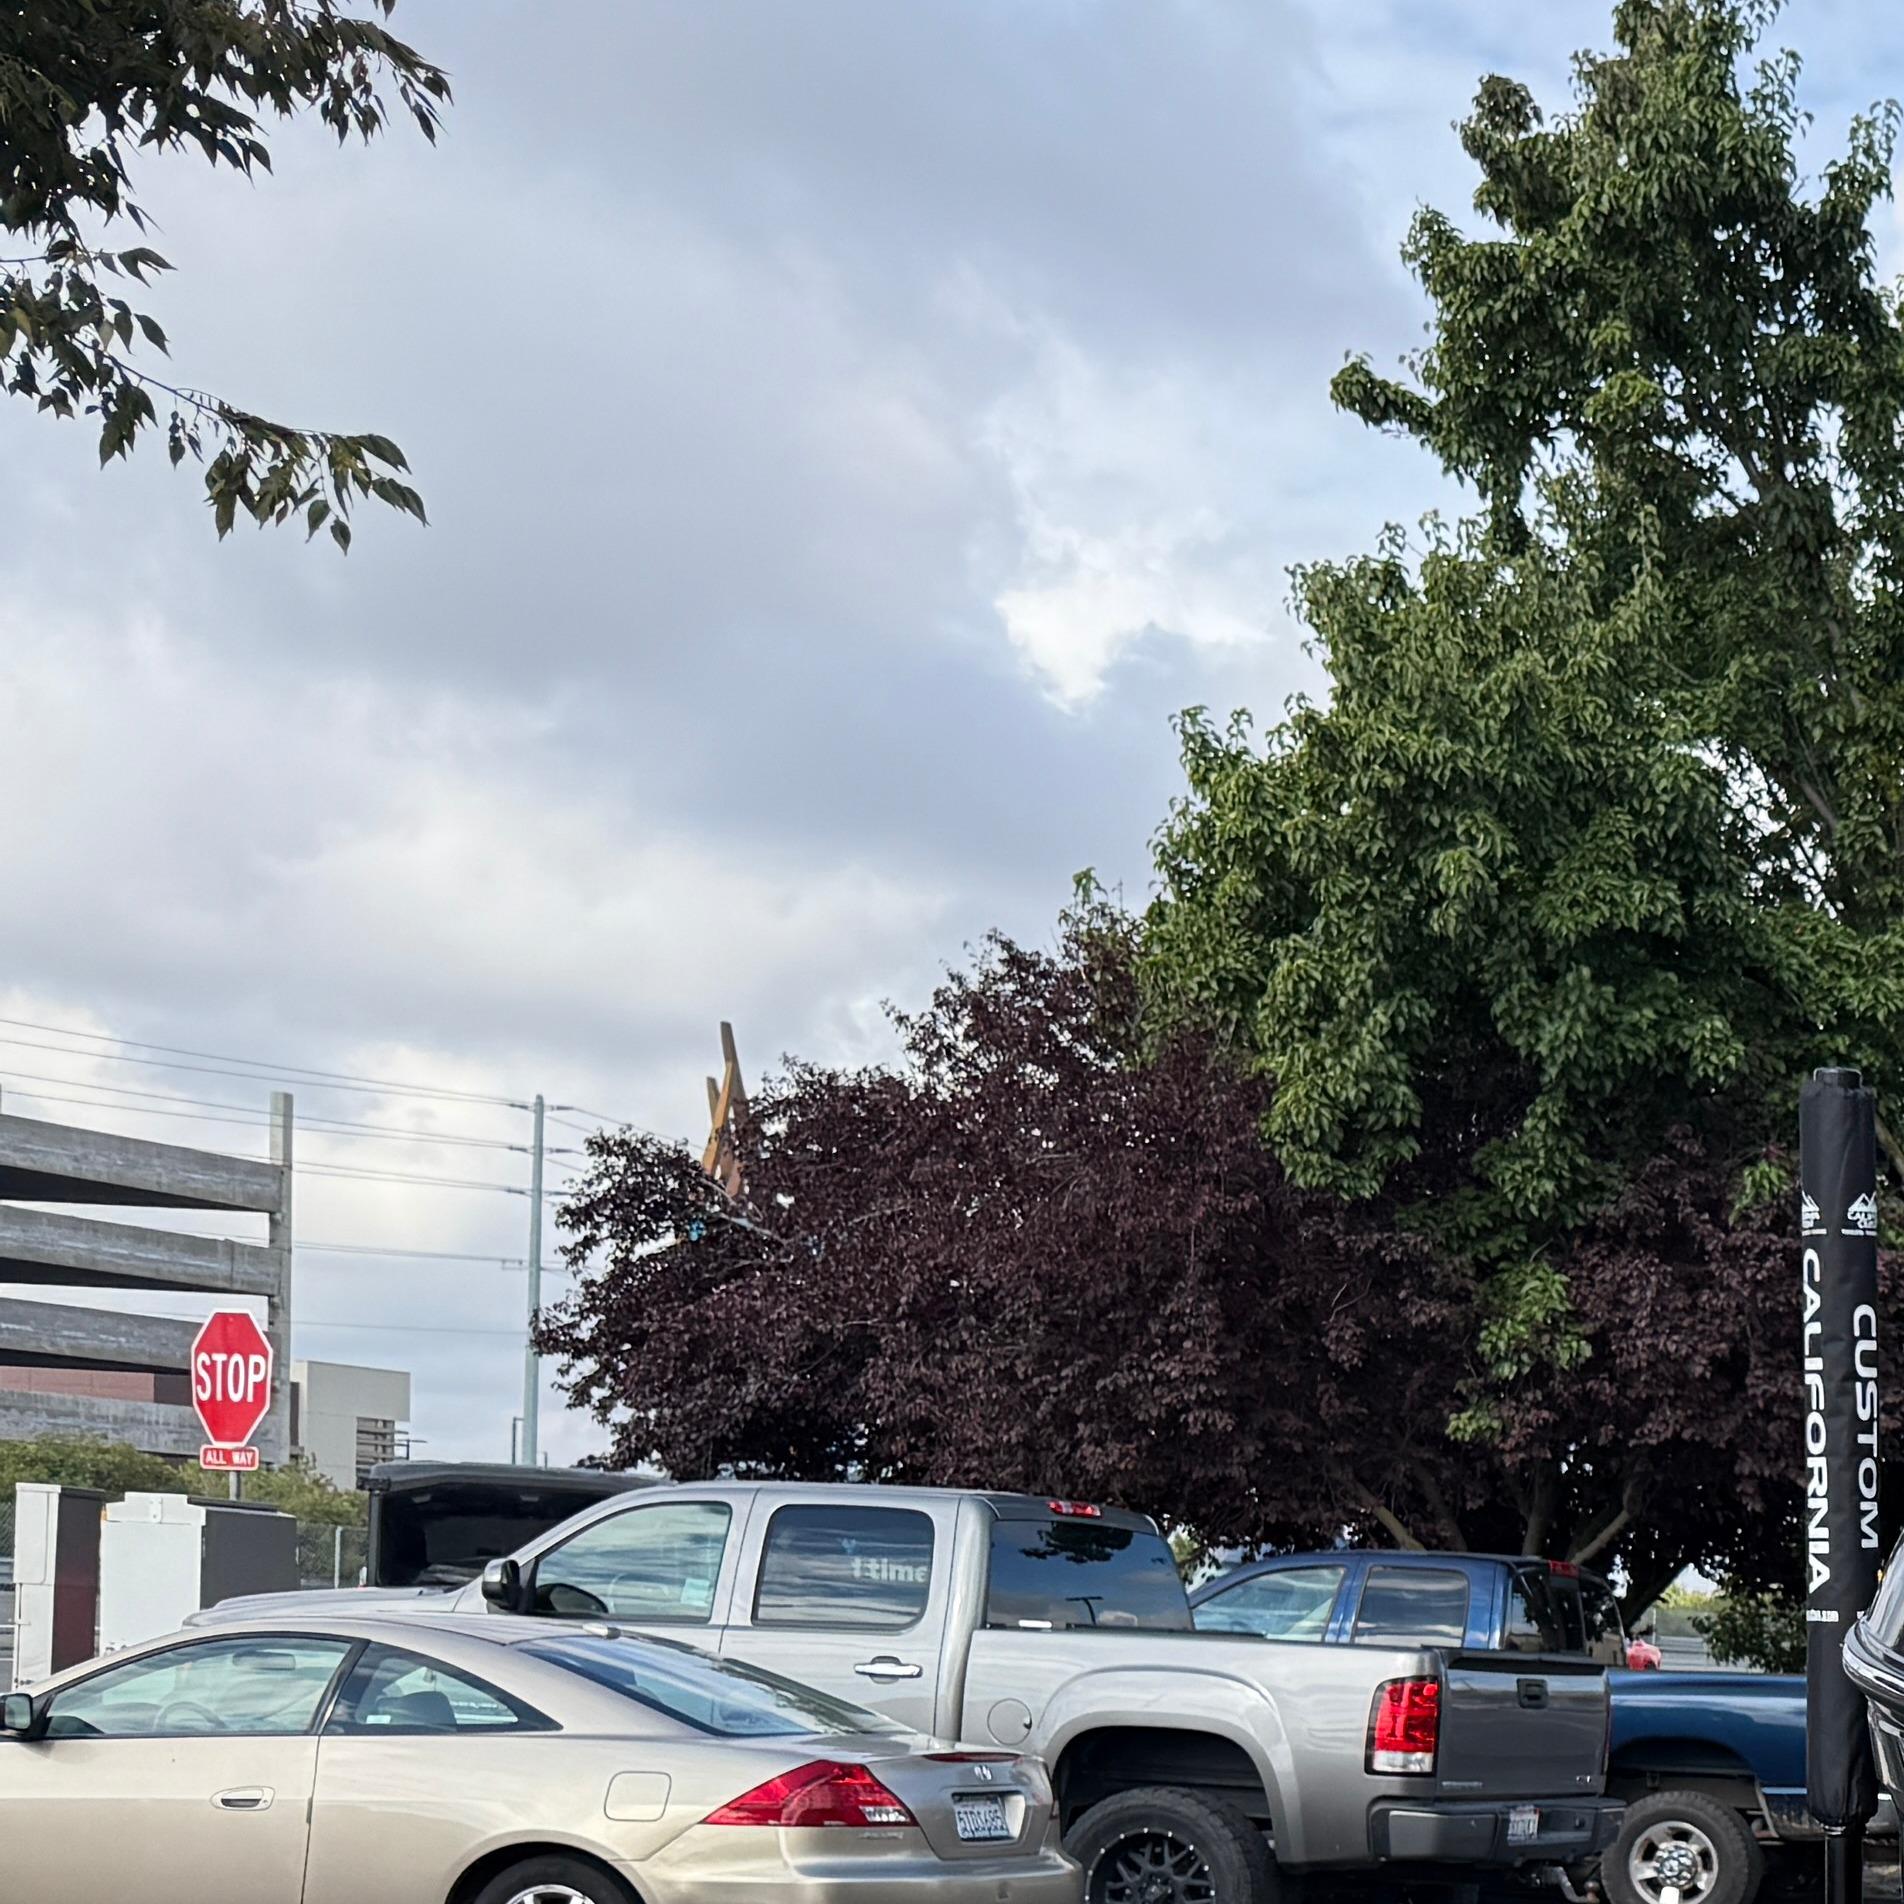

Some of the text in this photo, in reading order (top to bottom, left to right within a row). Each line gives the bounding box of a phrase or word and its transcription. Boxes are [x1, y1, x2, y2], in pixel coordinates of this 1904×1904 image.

[196, 1351, 266, 1403] STOP
[1802, 1247, 1831, 1595] CALIFORNIA
[1853, 1303, 1879, 1550] CUSTOM
[205, 1449, 254, 1467] ALL WAY
